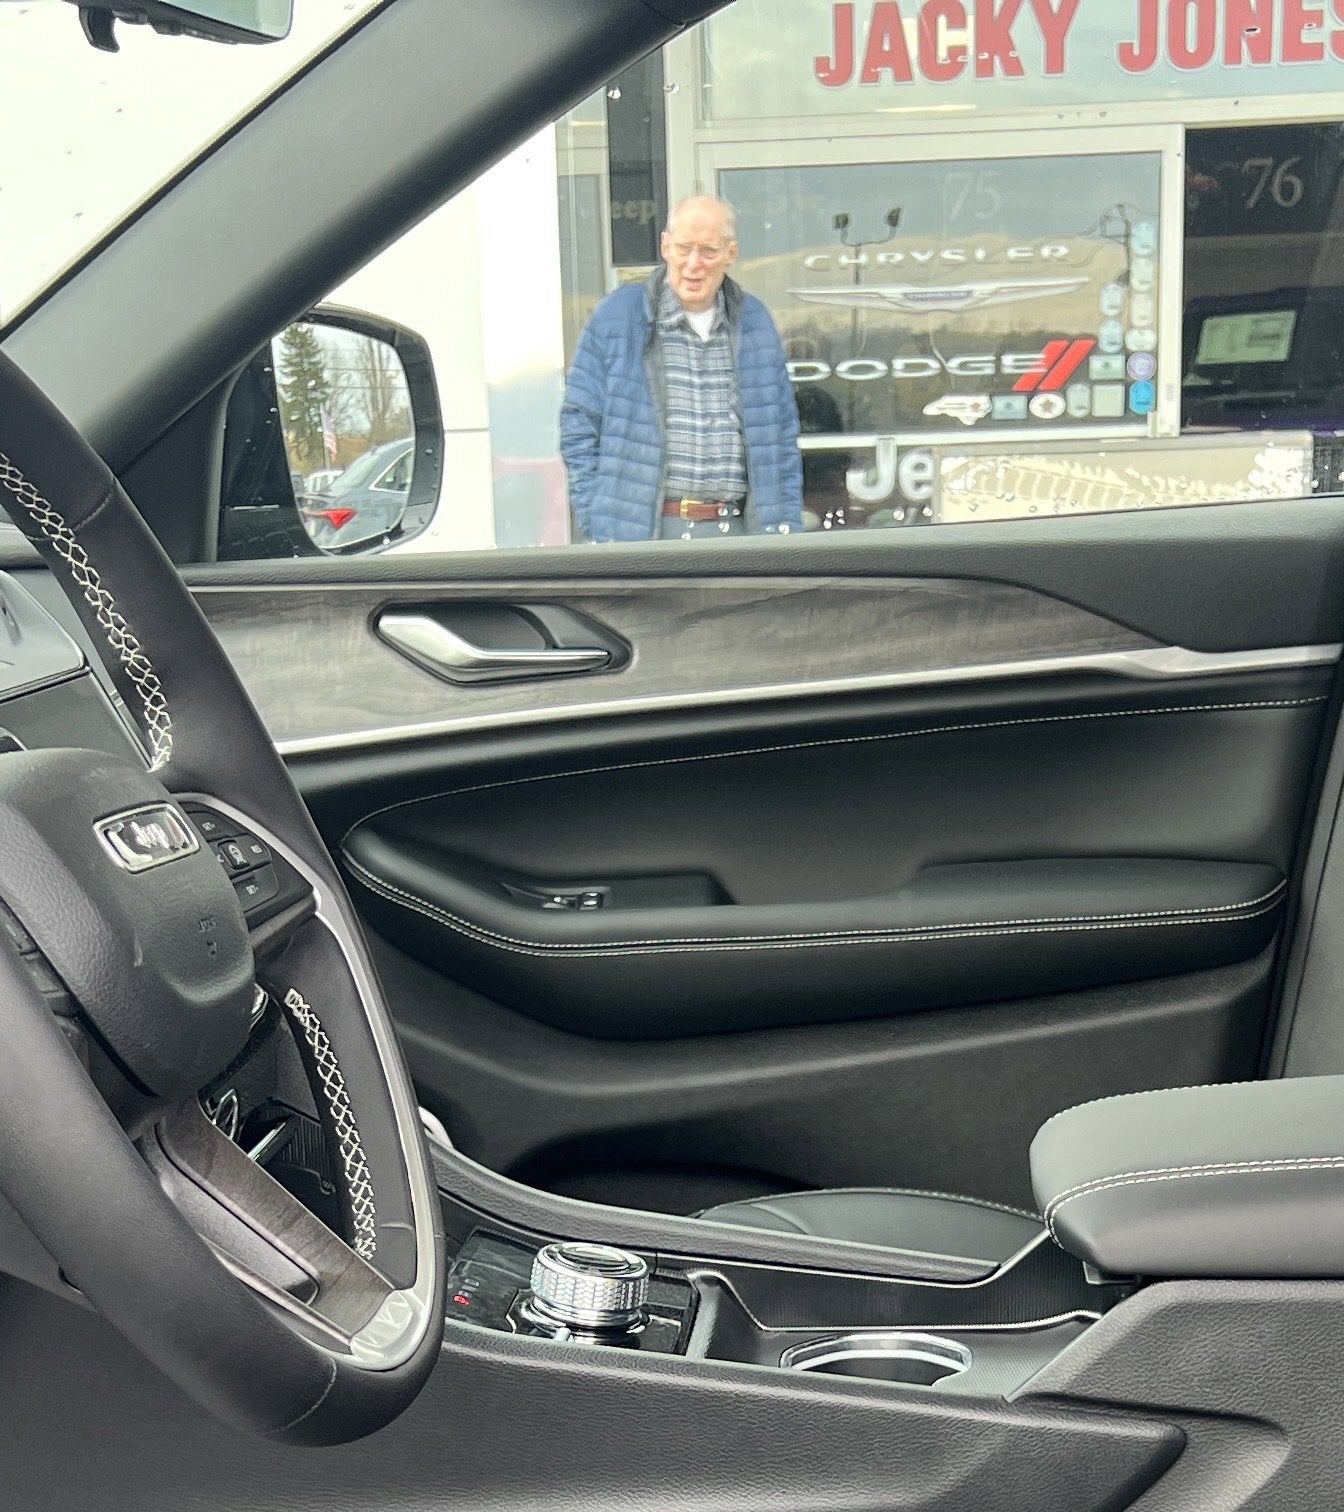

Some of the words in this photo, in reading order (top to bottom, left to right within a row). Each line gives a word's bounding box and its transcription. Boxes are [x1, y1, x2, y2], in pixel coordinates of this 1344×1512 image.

[812, 0, 1080, 87] JACKY
[1242, 155, 1305, 209] 76
[803, 244, 1072, 270] CHRYSLER
[785, 353, 1049, 382] DODGE
